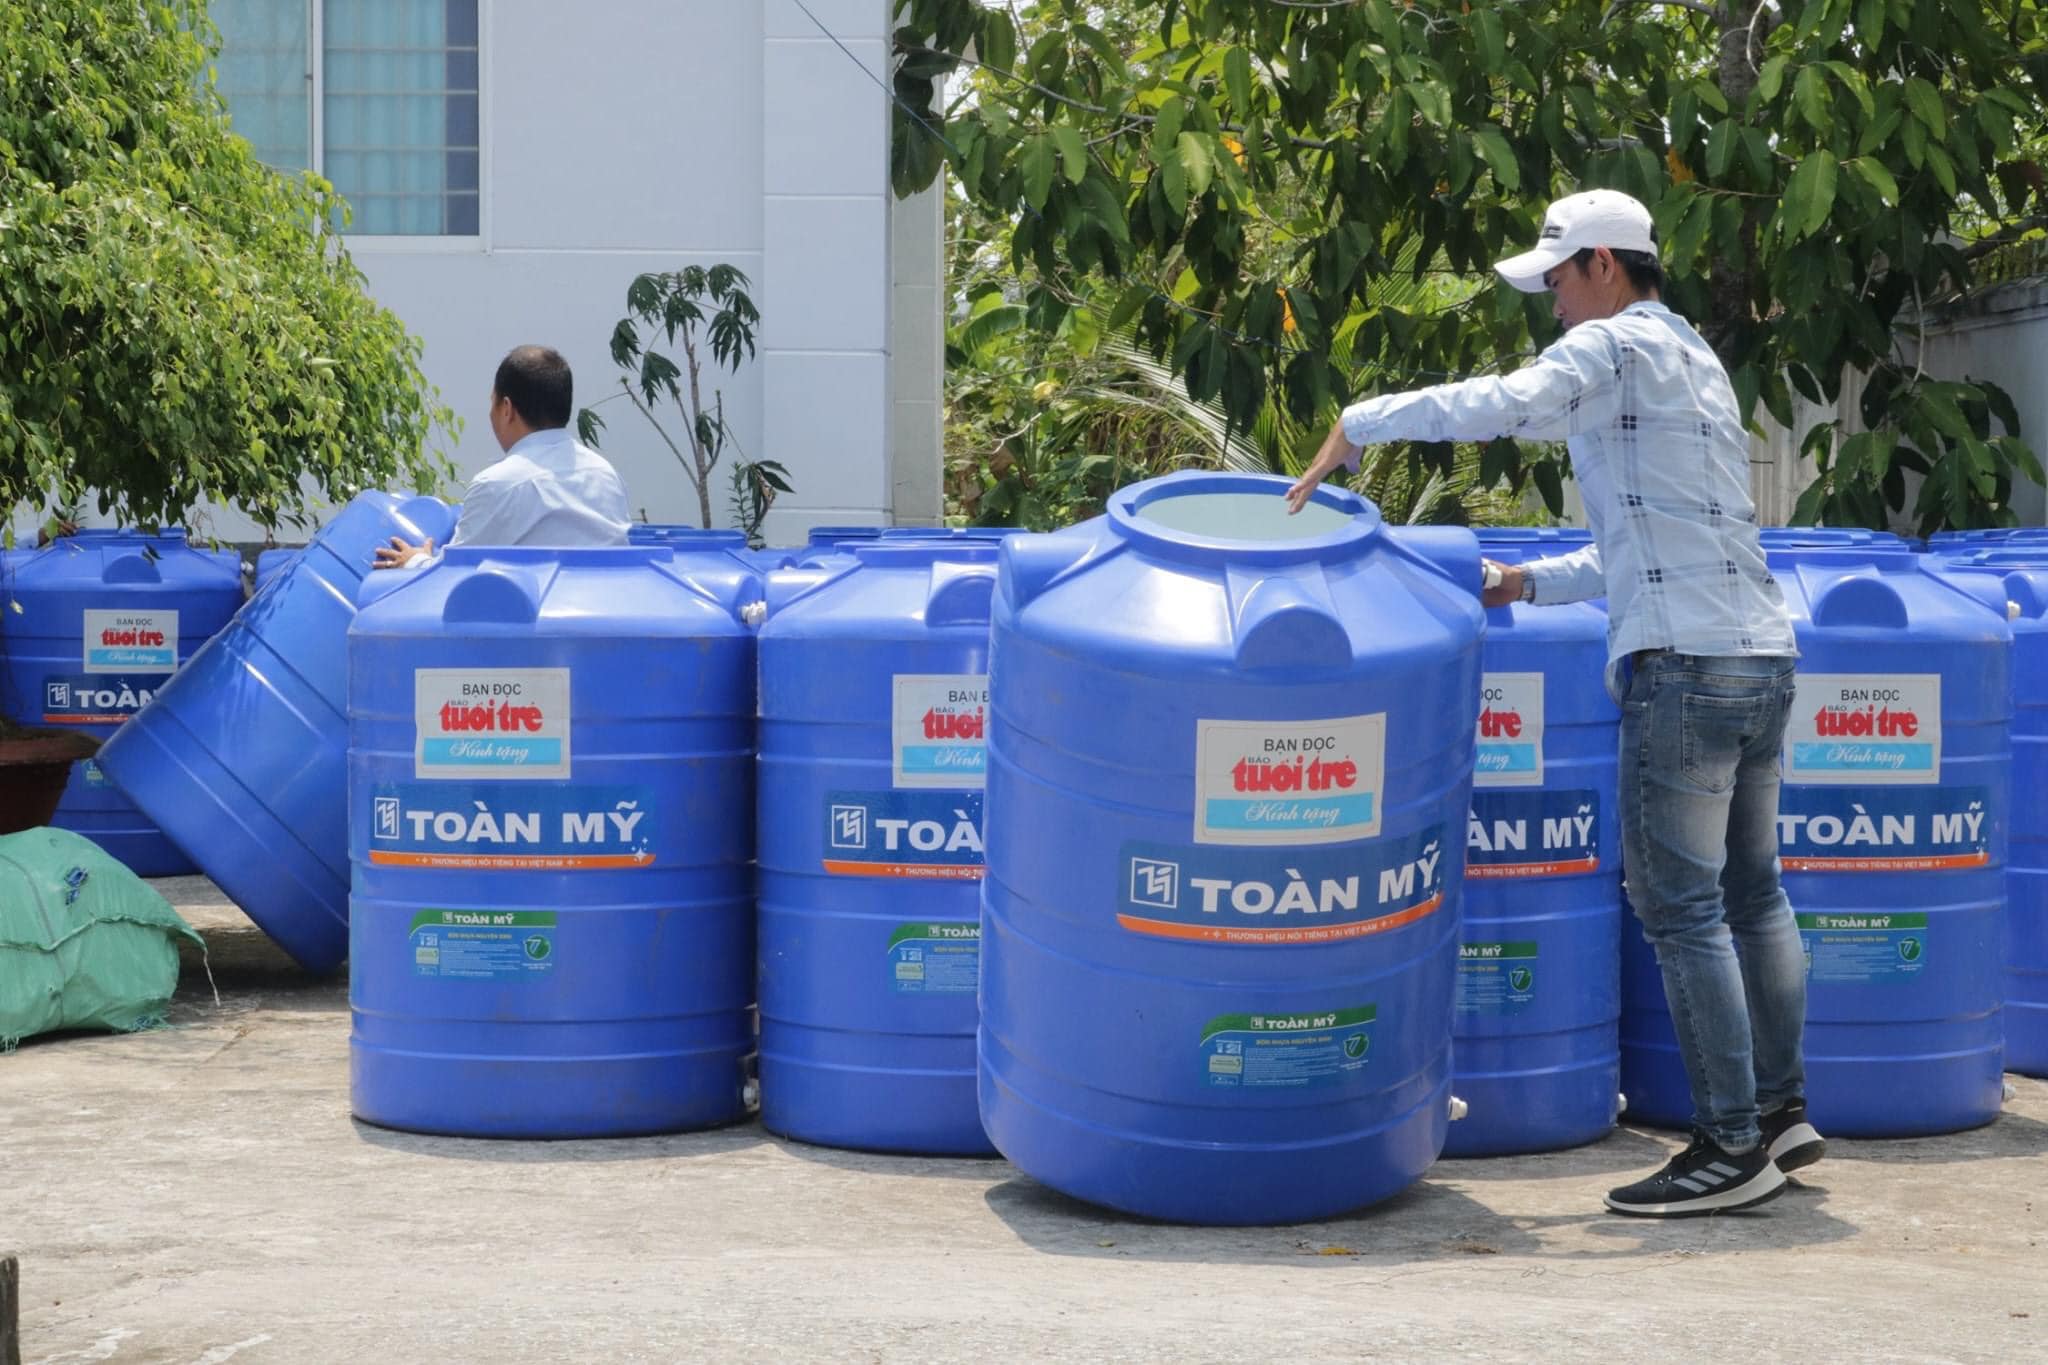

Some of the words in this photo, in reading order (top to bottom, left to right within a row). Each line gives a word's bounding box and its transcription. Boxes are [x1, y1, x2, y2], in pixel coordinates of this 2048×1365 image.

[462, 684, 489, 698] BẠN
[493, 684, 522, 698] ĐỌC
[948, 690, 978, 704] BẠN
[1480, 688, 1503, 703] ỌC
[1841, 689, 1868, 704] BẠN
[1872, 689, 1900, 704] ĐỌC
[1264, 738, 1297, 754] BẠN
[1303, 736, 1336, 754] ĐỌC
[406, 800, 540, 843] TOÀN
[562, 800, 644, 843] MỸ
[1467, 809, 1526, 852] ÀN
[1543, 803, 1595, 849] MỸ
[1777, 803, 1915, 845] TOÀN
[1932, 800, 1984, 844] MỸ
[875, 809, 984, 852] TOÀ
[1190, 868, 1360, 915] TOÀN
[1378, 839, 1441, 904] MỸ
[454, 913, 489, 925] TOÀN
[494, 913, 515, 925] MỸ
[1830, 916, 1867, 928] TOÀN
[1871, 916, 1891, 928] MỸ
[1459, 945, 1478, 957] ÀN
[1266, 1015, 1309, 1029] TOÀN
[1313, 1013, 1337, 1028] MỸ
